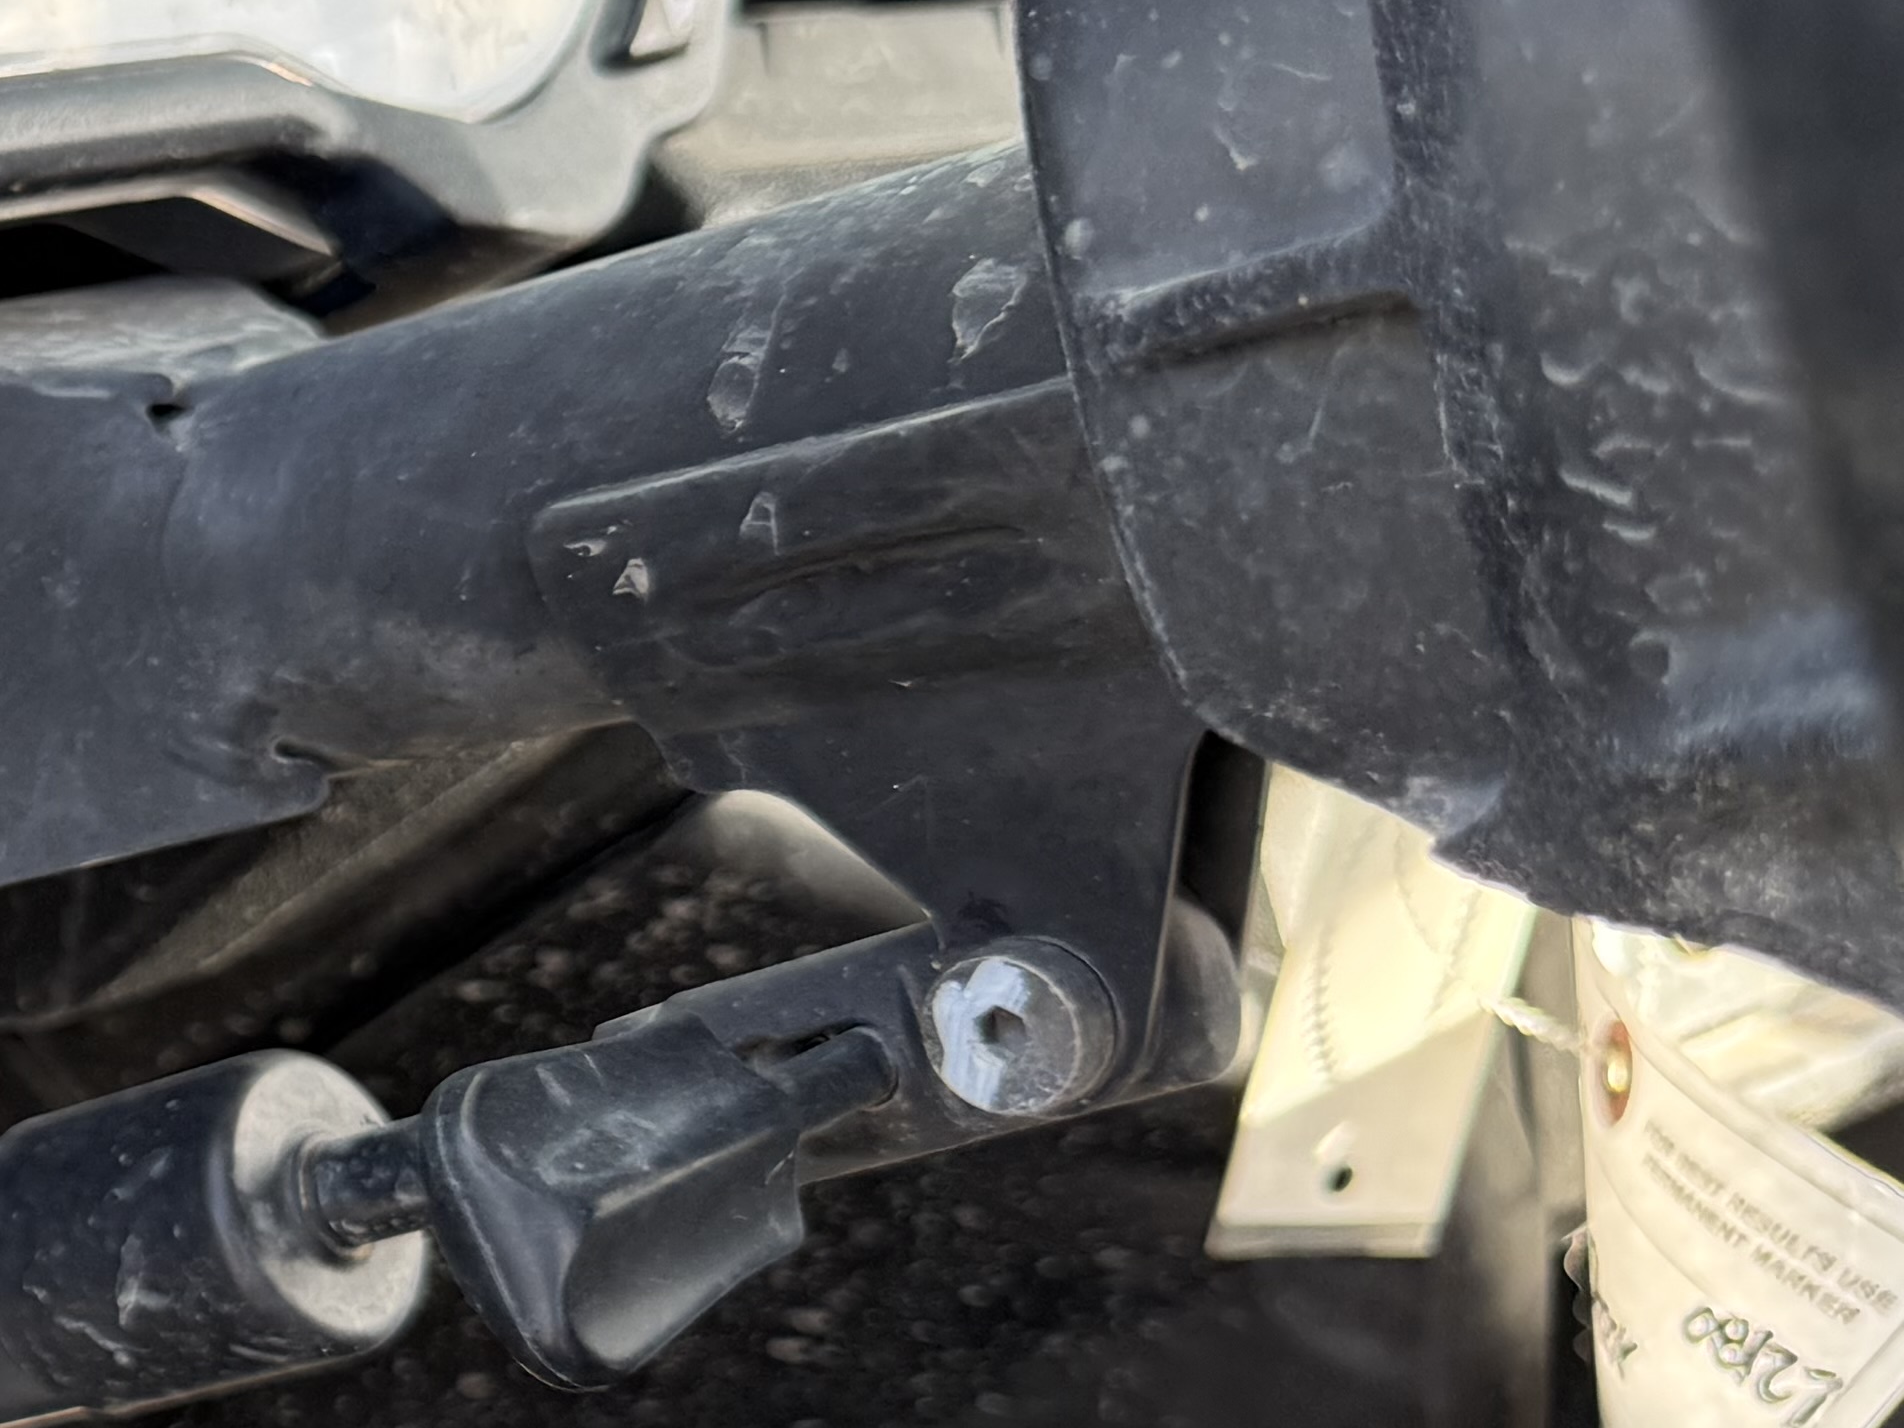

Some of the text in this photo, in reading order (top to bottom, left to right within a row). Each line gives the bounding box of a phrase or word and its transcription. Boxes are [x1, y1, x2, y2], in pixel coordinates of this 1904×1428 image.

[1642, 1152, 1861, 1325] PERMANENT MARKER
[1726, 1191, 1838, 1272] RESULTS
[1837, 1266, 1898, 1310] USE
